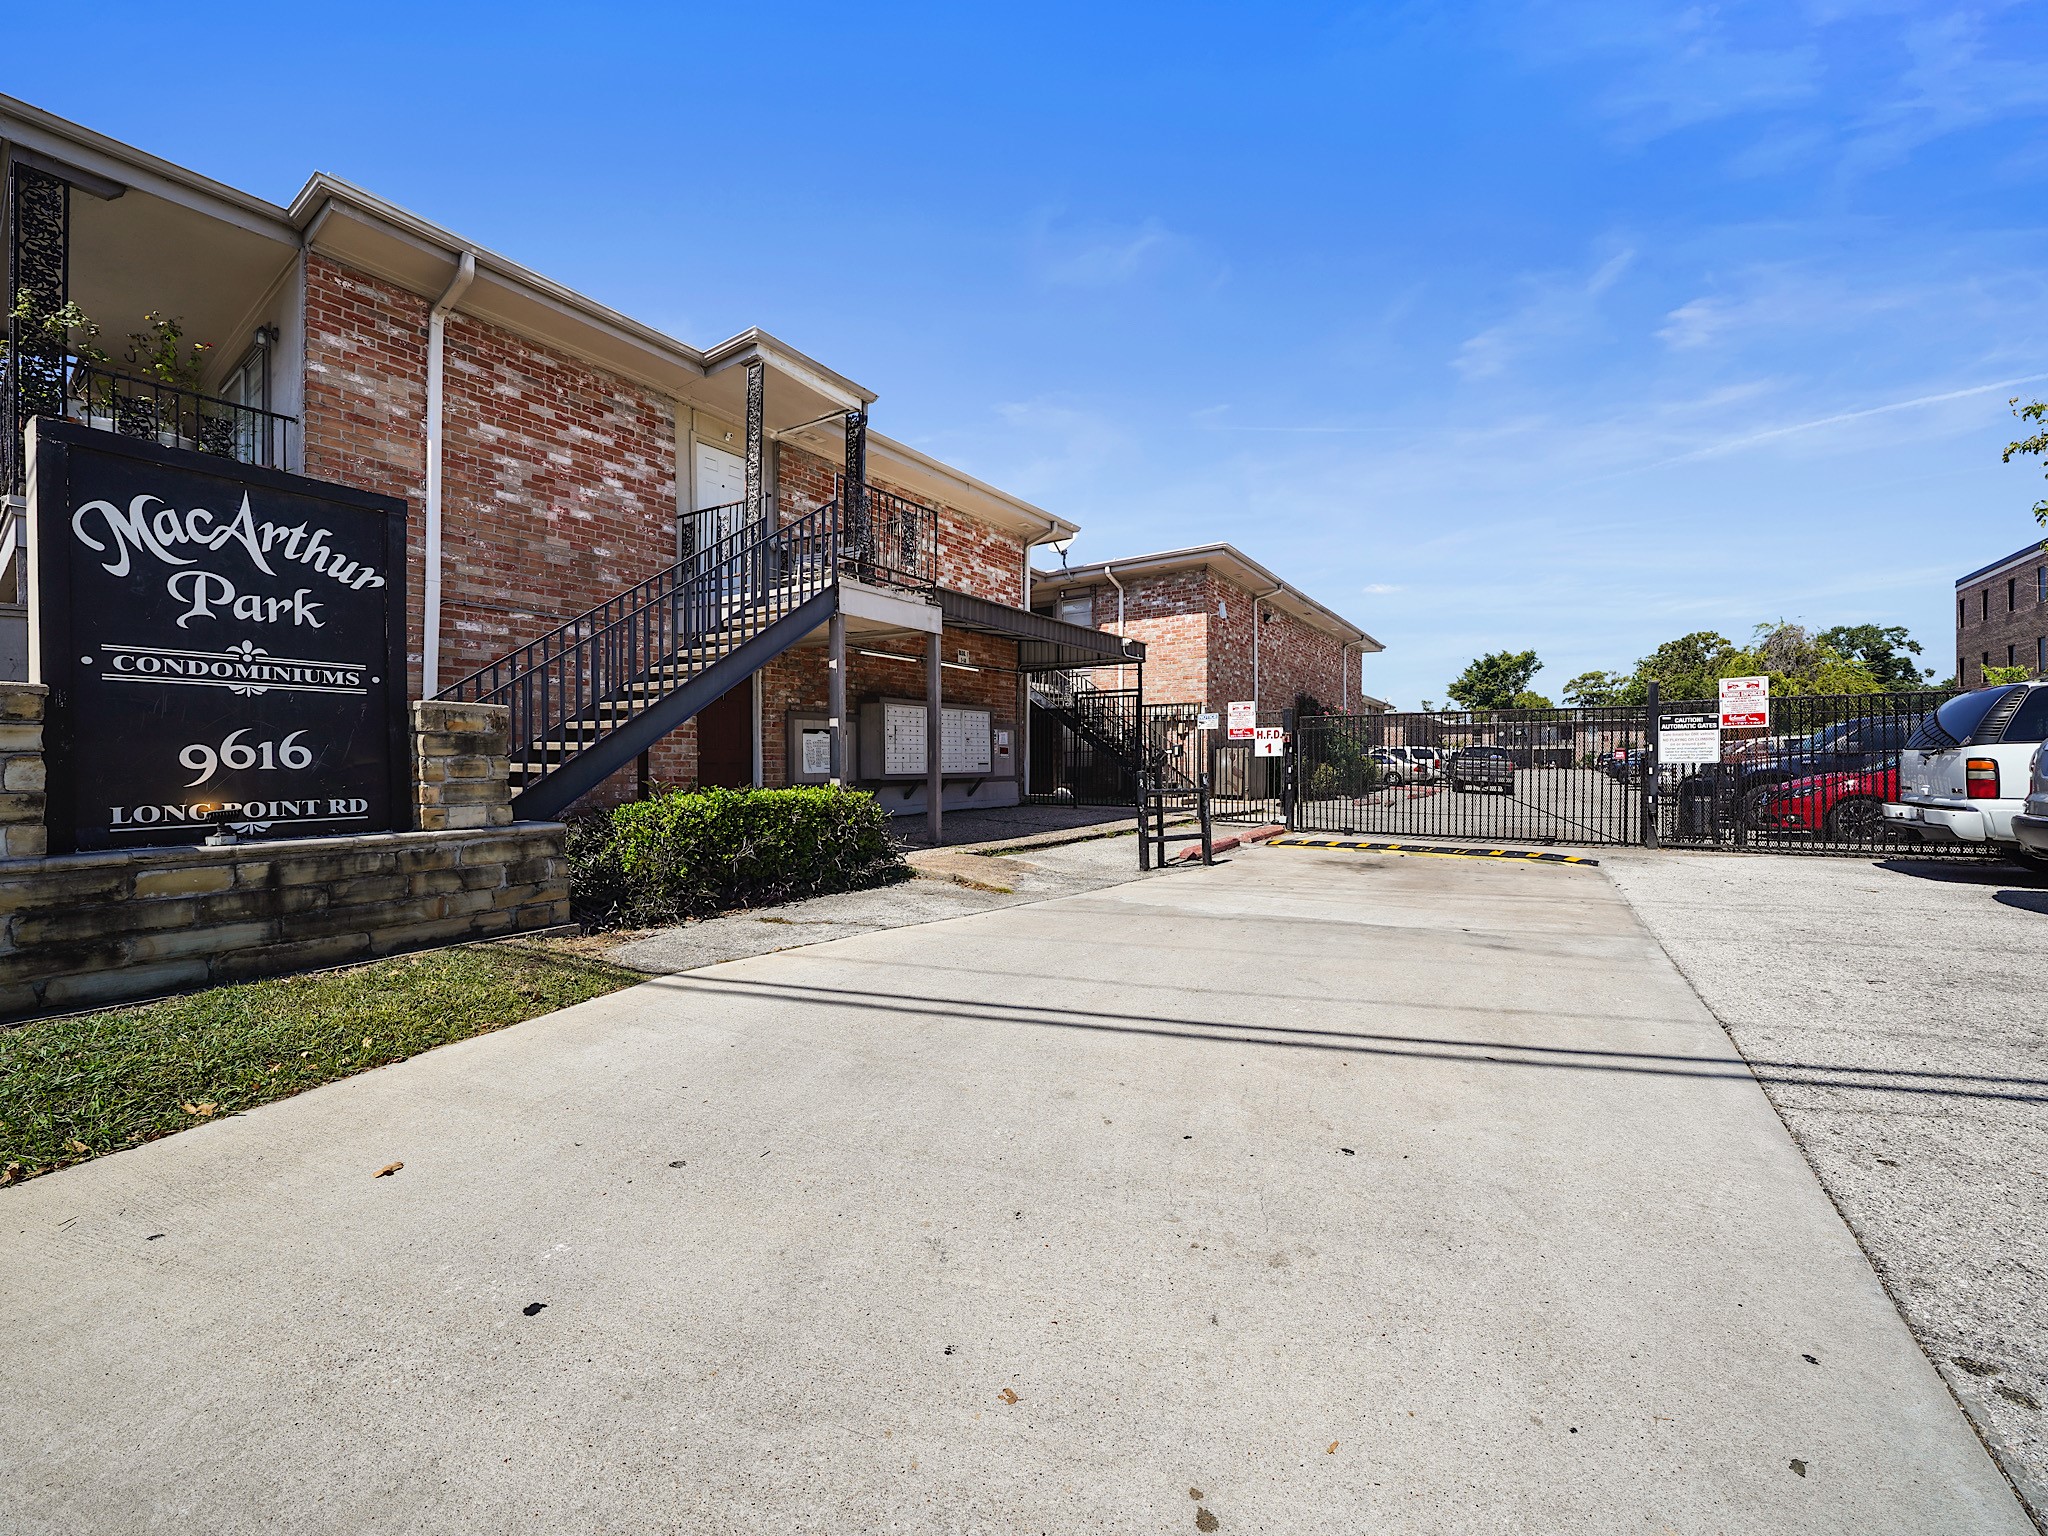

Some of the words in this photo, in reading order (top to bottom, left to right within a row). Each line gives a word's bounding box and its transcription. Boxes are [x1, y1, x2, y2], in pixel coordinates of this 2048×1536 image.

[72, 490, 385, 590] MacArthur
[167, 571, 326, 629] Park
[112, 655, 361, 686] CONDOMINIUMS
[178, 728, 313, 788] 9616
[1265, 744, 1272, 754] 1
[109, 803, 211, 825] LONG
[328, 798, 368, 814] RD
